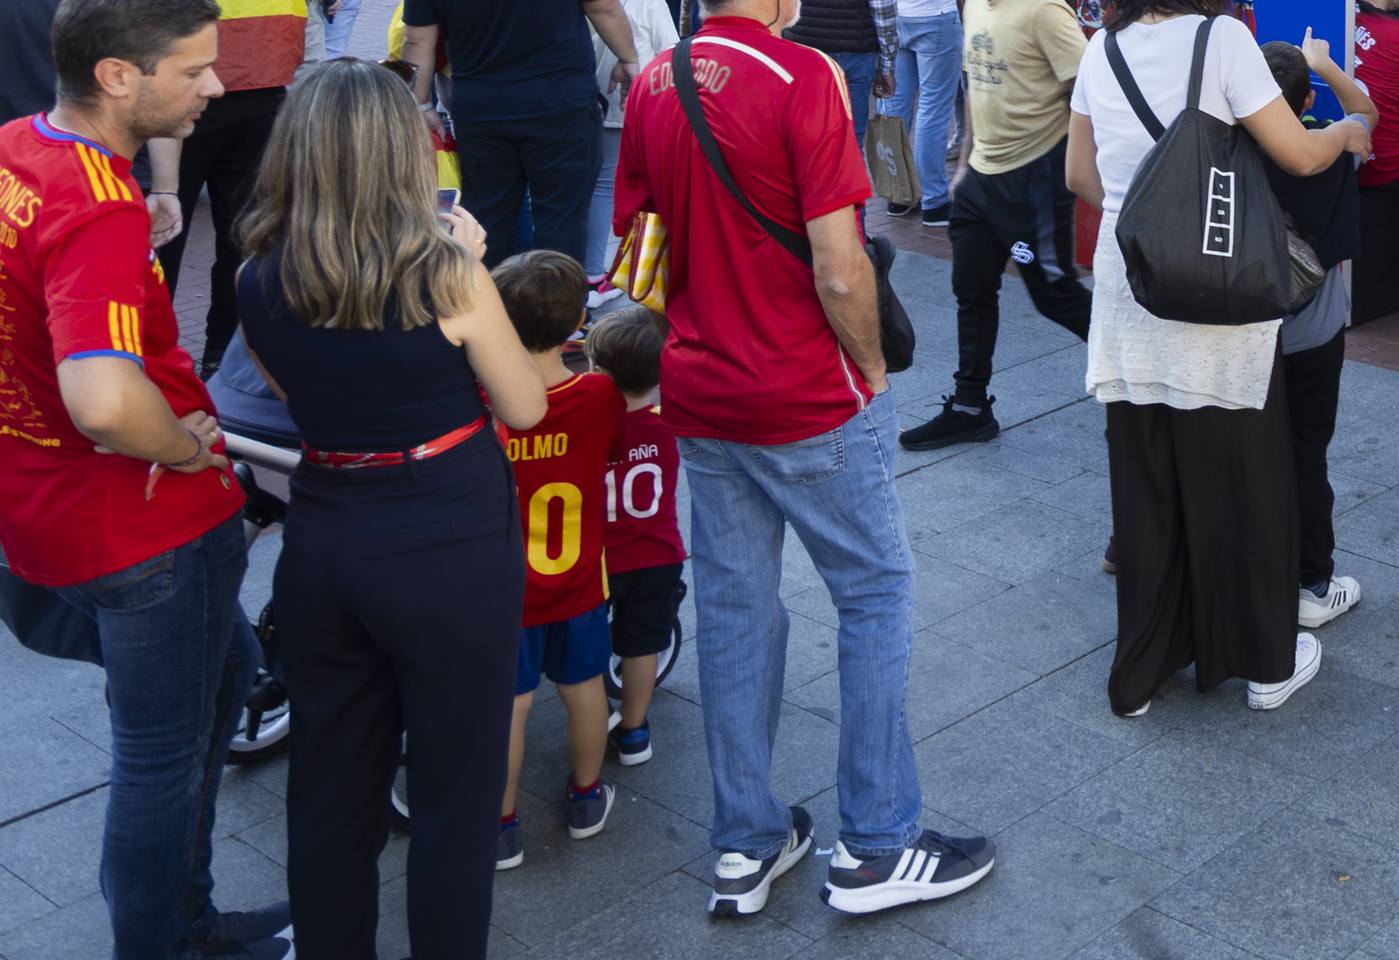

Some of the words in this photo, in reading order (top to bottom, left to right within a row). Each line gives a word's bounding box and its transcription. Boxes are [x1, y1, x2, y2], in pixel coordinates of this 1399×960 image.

[507, 432, 568, 462] OLMO
[604, 462, 664, 523] 10
[527, 481, 583, 576] 0
